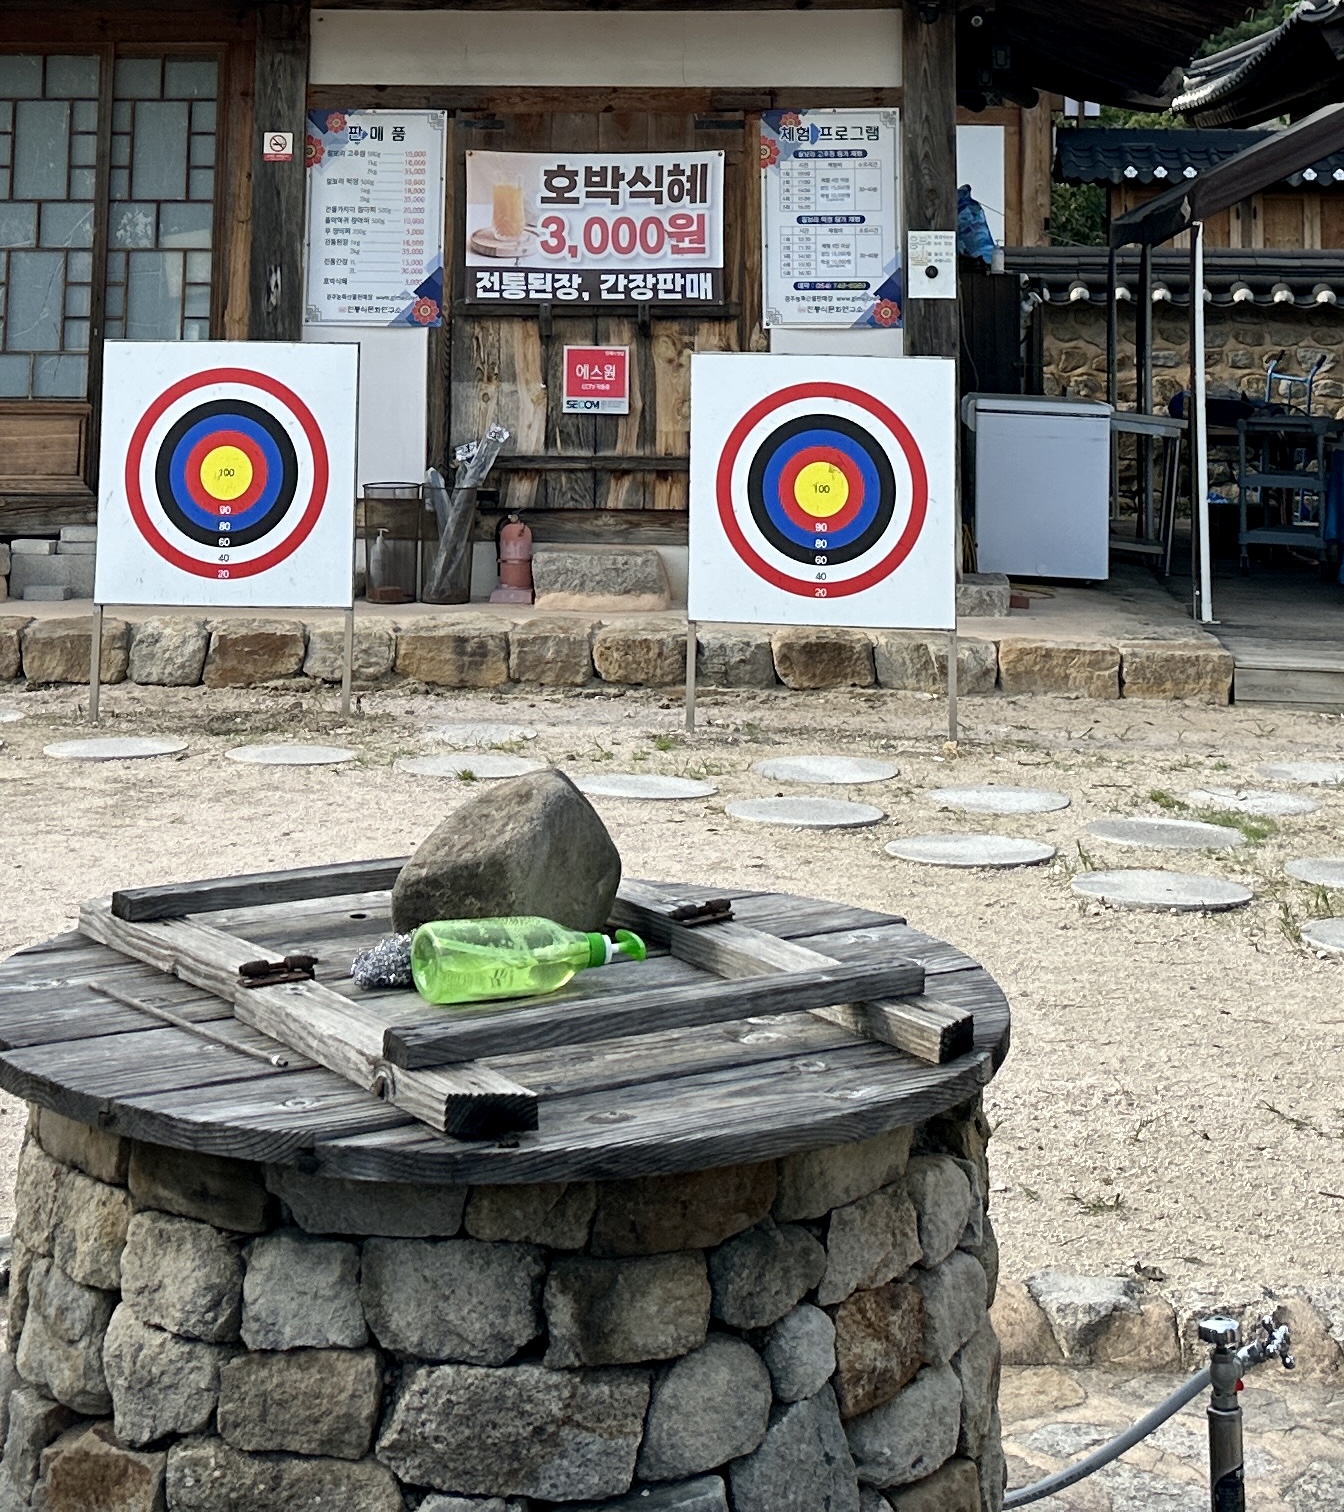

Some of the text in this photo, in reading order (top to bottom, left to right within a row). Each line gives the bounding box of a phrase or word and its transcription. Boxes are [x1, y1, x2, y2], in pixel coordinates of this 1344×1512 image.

[780, 125, 880, 142] 체험 프로그램
[540, 163, 708, 206] 호박식혜
[540, 213, 706, 258] 3,000원
[475, 272, 713, 301] 전통된장, 간장판매
[575, 364, 616, 381] 에스원
[566, 399, 600, 409] SECOM
[218, 468, 235, 477] 100
[813, 484, 830, 494] 100
[219, 506, 231, 514] 90
[219, 522, 231, 531] 80
[814, 523, 827, 532] 90
[218, 538, 230, 546] 60
[815, 539, 827, 548] 80
[218, 554, 229, 562] 40
[815, 556, 827, 564] 60
[218, 570, 229, 578] 20
[815, 572, 827, 580] 40
[815, 589, 827, 597] 20
